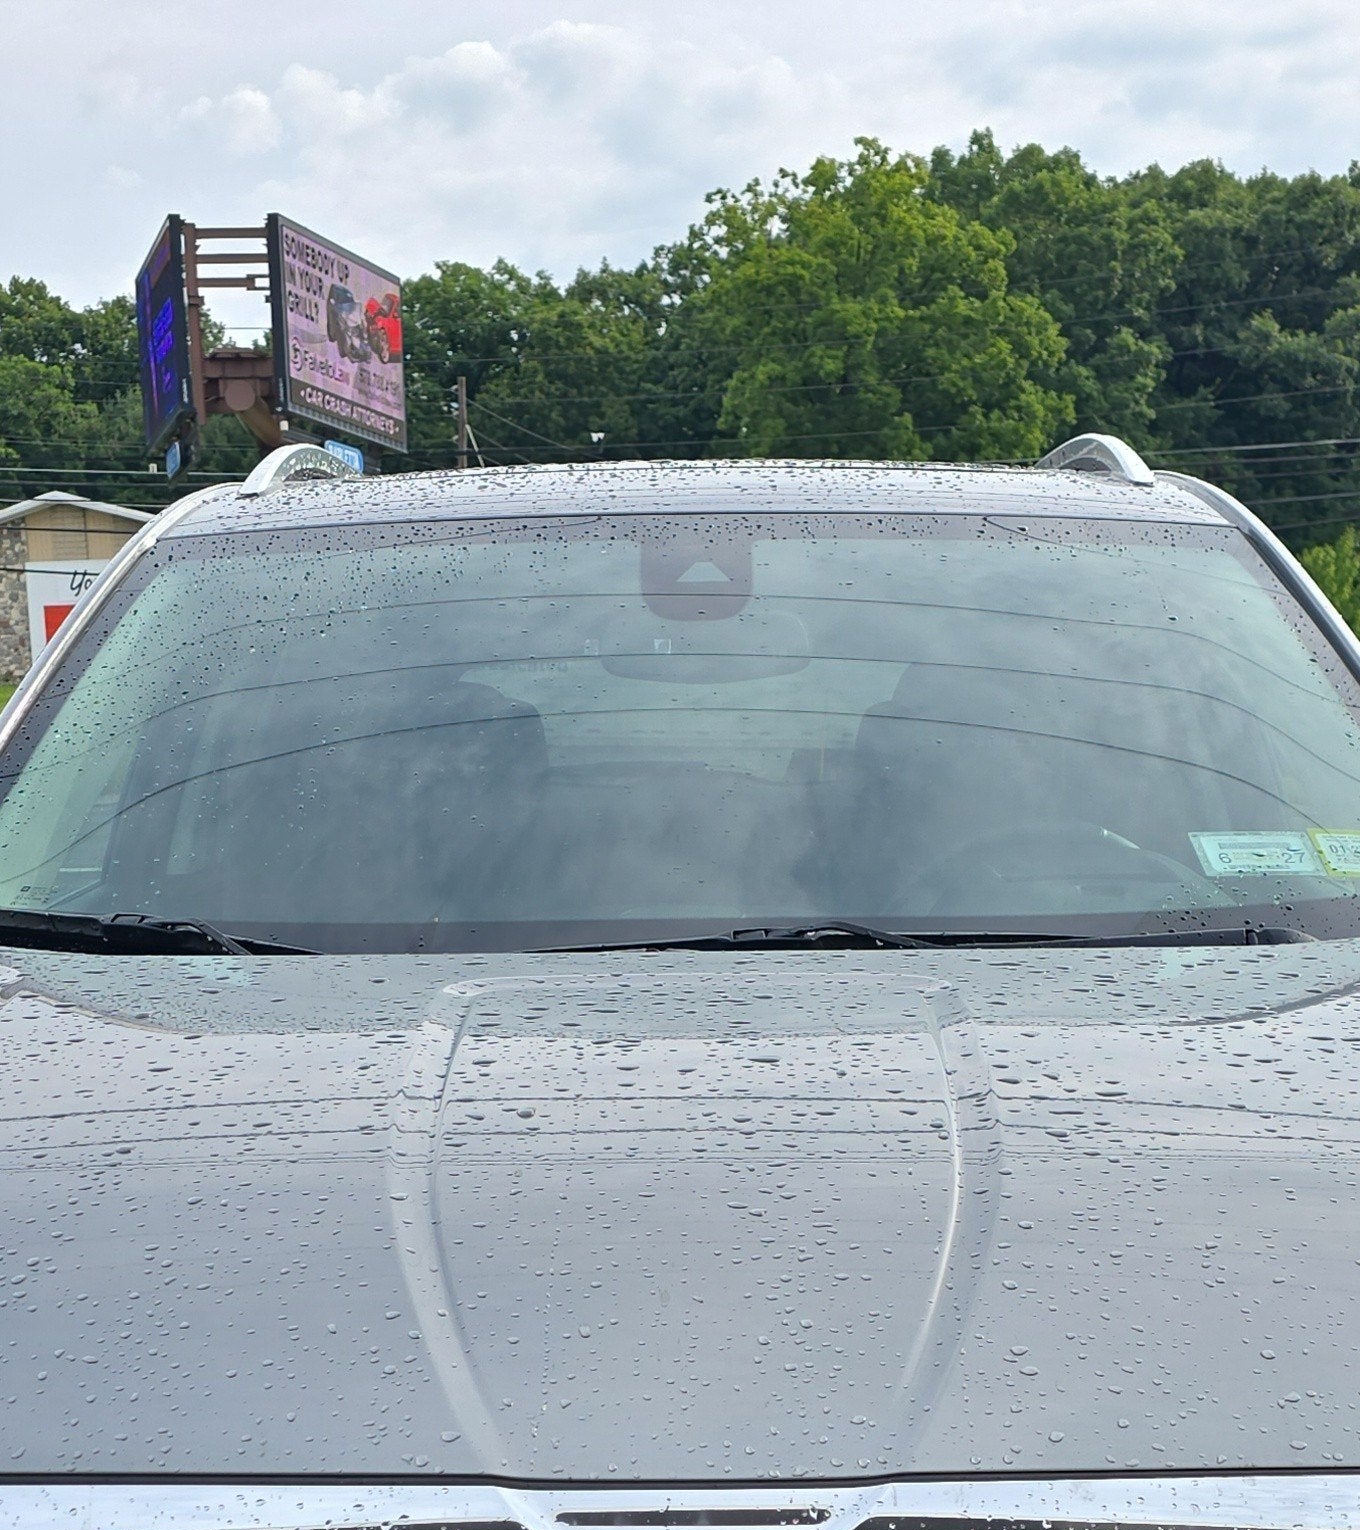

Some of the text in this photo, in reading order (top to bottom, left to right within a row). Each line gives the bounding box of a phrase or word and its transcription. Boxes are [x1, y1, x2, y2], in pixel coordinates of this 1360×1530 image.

[284, 233, 336, 279] SOMEBODY
[70, 569, 93, 597] Yo
[1219, 852, 1305, 863] 6 27
